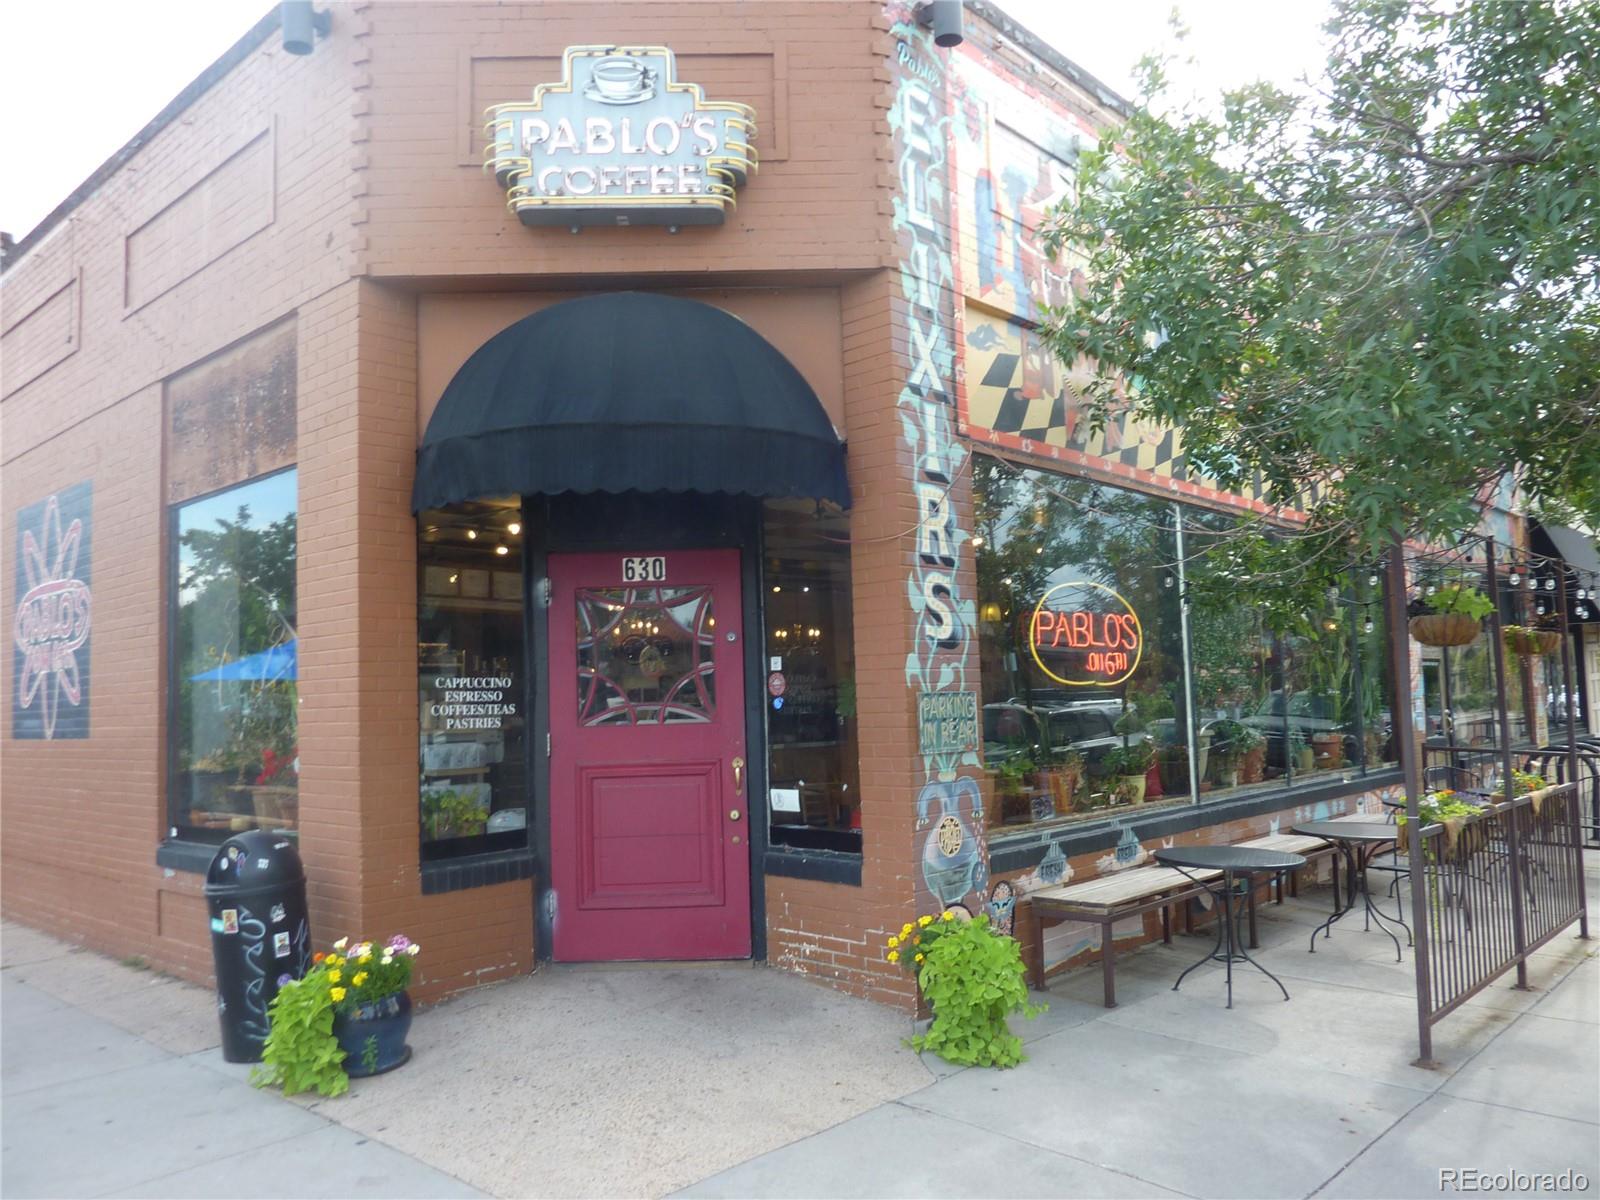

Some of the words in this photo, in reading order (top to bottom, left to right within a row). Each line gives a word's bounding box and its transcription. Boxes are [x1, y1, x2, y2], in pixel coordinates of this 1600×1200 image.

[520, 112, 719, 156] PABLO'S
[537, 165, 702, 196] COFFEE
[903, 85, 960, 645] ELIXIRS
[624, 558, 664, 580] 630
[1036, 610, 1137, 650] PABLO'S
[435, 677, 512, 689] CAPPUCCINO
[445, 691, 503, 702] ESPRESSO
[922, 696, 975, 719] PARKING
[431, 703, 516, 717] COFFEES/TEAS
[446, 717, 502, 730] PASTRIES
[924, 721, 937, 746] IN
[941, 719, 975, 745] REAR
